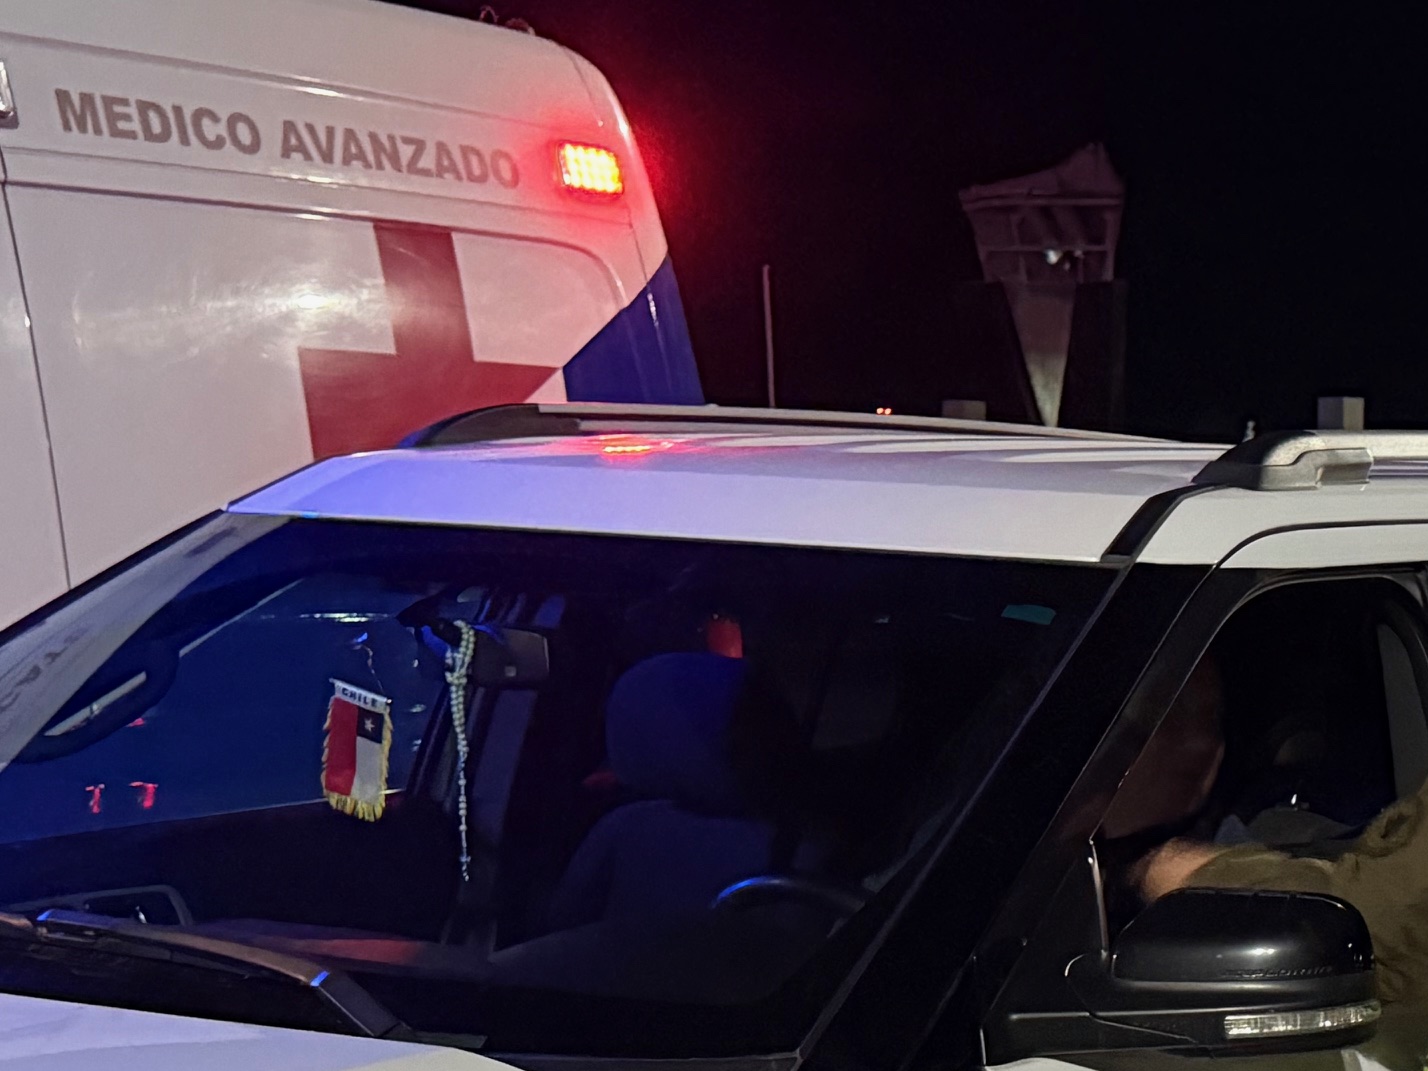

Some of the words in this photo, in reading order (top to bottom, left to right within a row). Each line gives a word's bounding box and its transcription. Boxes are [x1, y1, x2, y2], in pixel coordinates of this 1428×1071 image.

[54, 88, 261, 155] MEDICO
[281, 120, 520, 190] AVANZADO
[342, 687, 378, 708] CHILE
